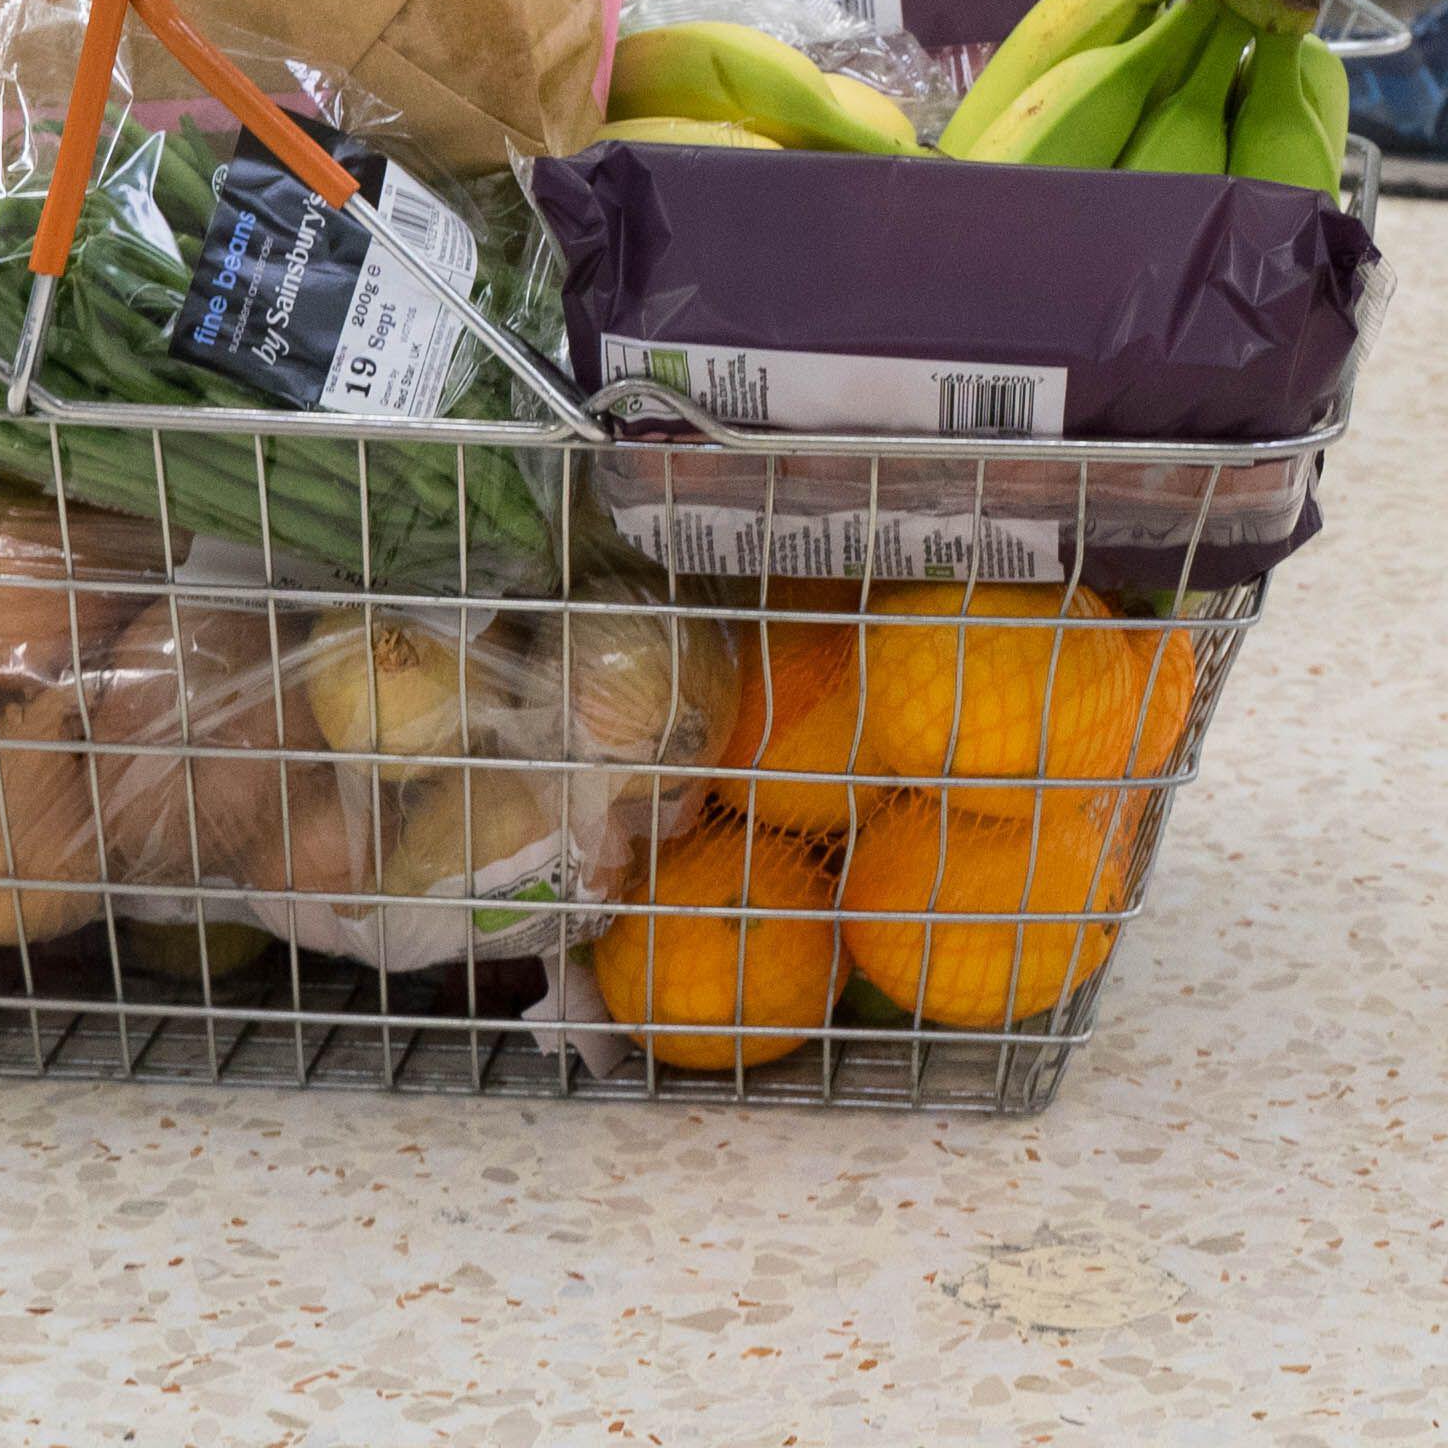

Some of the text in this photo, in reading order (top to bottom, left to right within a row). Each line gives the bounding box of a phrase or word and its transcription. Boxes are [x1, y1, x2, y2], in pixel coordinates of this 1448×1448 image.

[193, 210, 257, 345] fine beans
[228, 296, 253, 354] succulent
[252, 192, 328, 366] by Sainsbury's
[352, 280, 380, 328] 200g
[345, 303, 397, 399] 19 Sept
